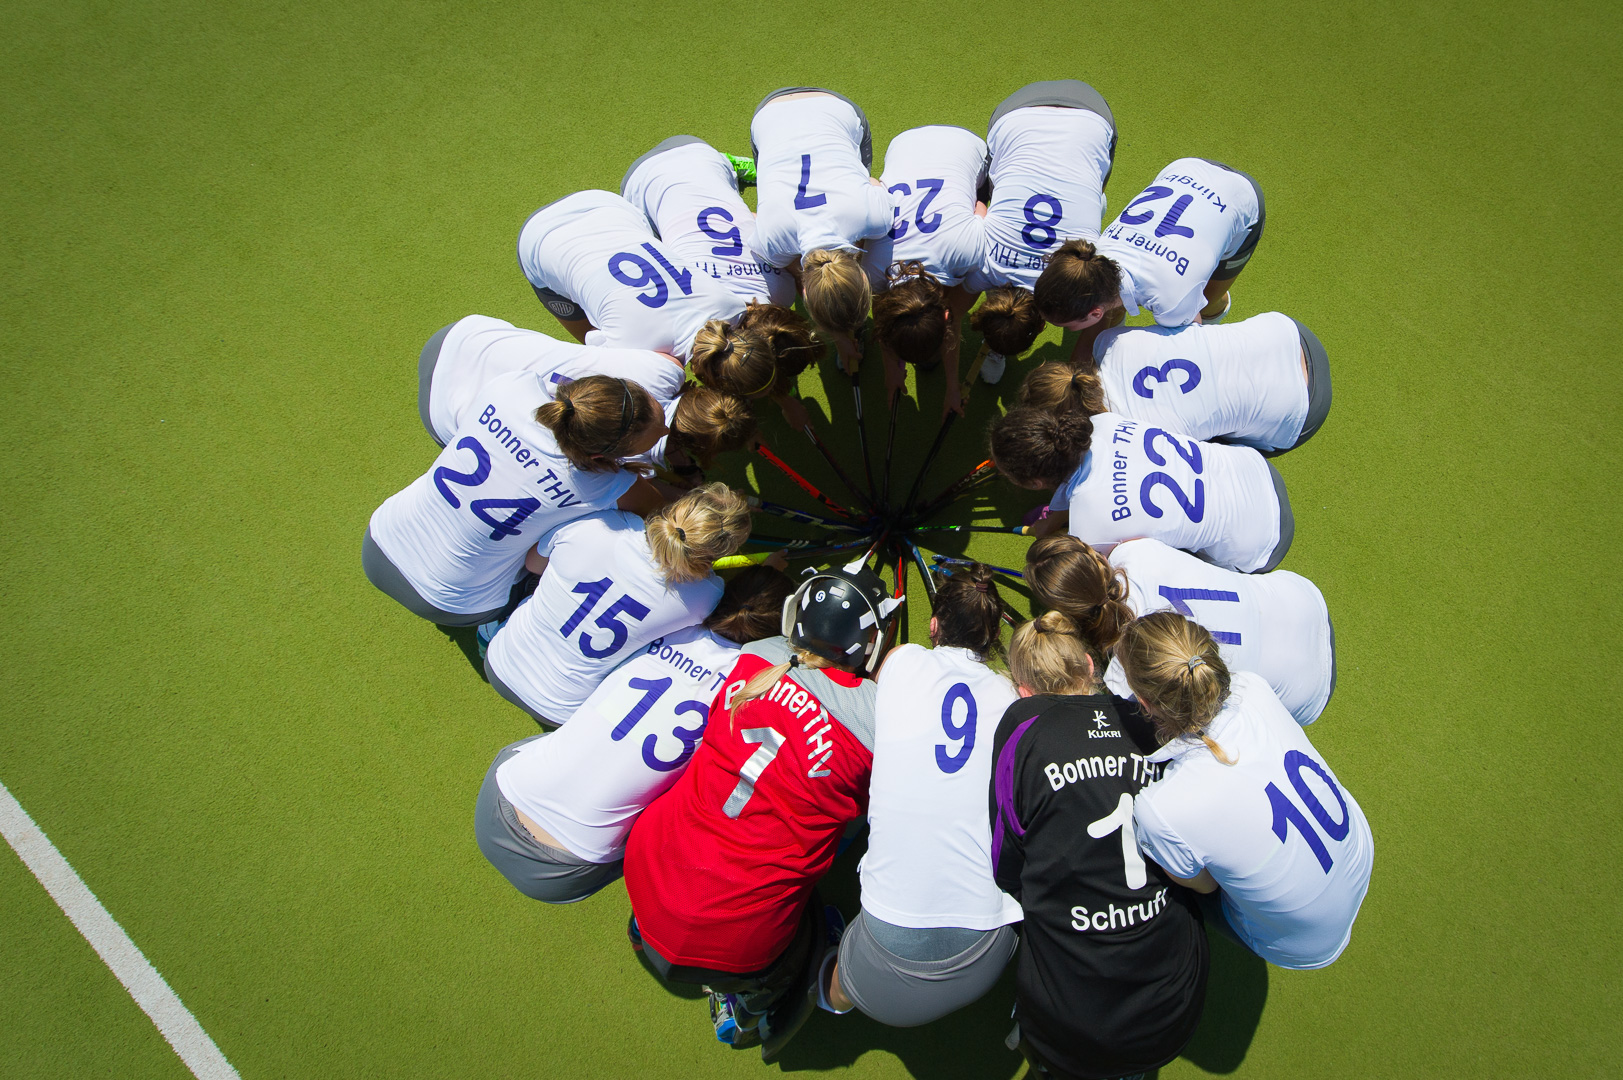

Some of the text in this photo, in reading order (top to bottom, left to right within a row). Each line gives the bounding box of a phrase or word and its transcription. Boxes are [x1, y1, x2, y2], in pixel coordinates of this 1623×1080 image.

[794, 154, 827, 210] 7
[1119, 185, 1194, 239] 12
[697, 206, 743, 256] 5
[989, 242, 1019, 268] THV
[1021, 194, 1062, 250] 8
[1126, 232, 1190, 276] Bonner
[608, 242, 693, 308] 16
[1132, 358, 1201, 399] 3
[433, 436, 541, 541] 24
[478, 404, 581, 508] Bonner THV
[1111, 450, 1132, 522] Bonner
[1140, 427, 1204, 524] 22
[559, 576, 651, 659] 15
[647, 636, 712, 682] Bonner
[610, 676, 710, 772] 13
[723, 679, 833, 778] Bnner THV
[935, 682, 978, 774] 9
[1087, 729, 1122, 739] KUKRI
[721, 726, 787, 820] 1
[1043, 752, 1161, 792] Bonner TH
[1086, 792, 1147, 890] 1
[1264, 749, 1350, 876] 10
